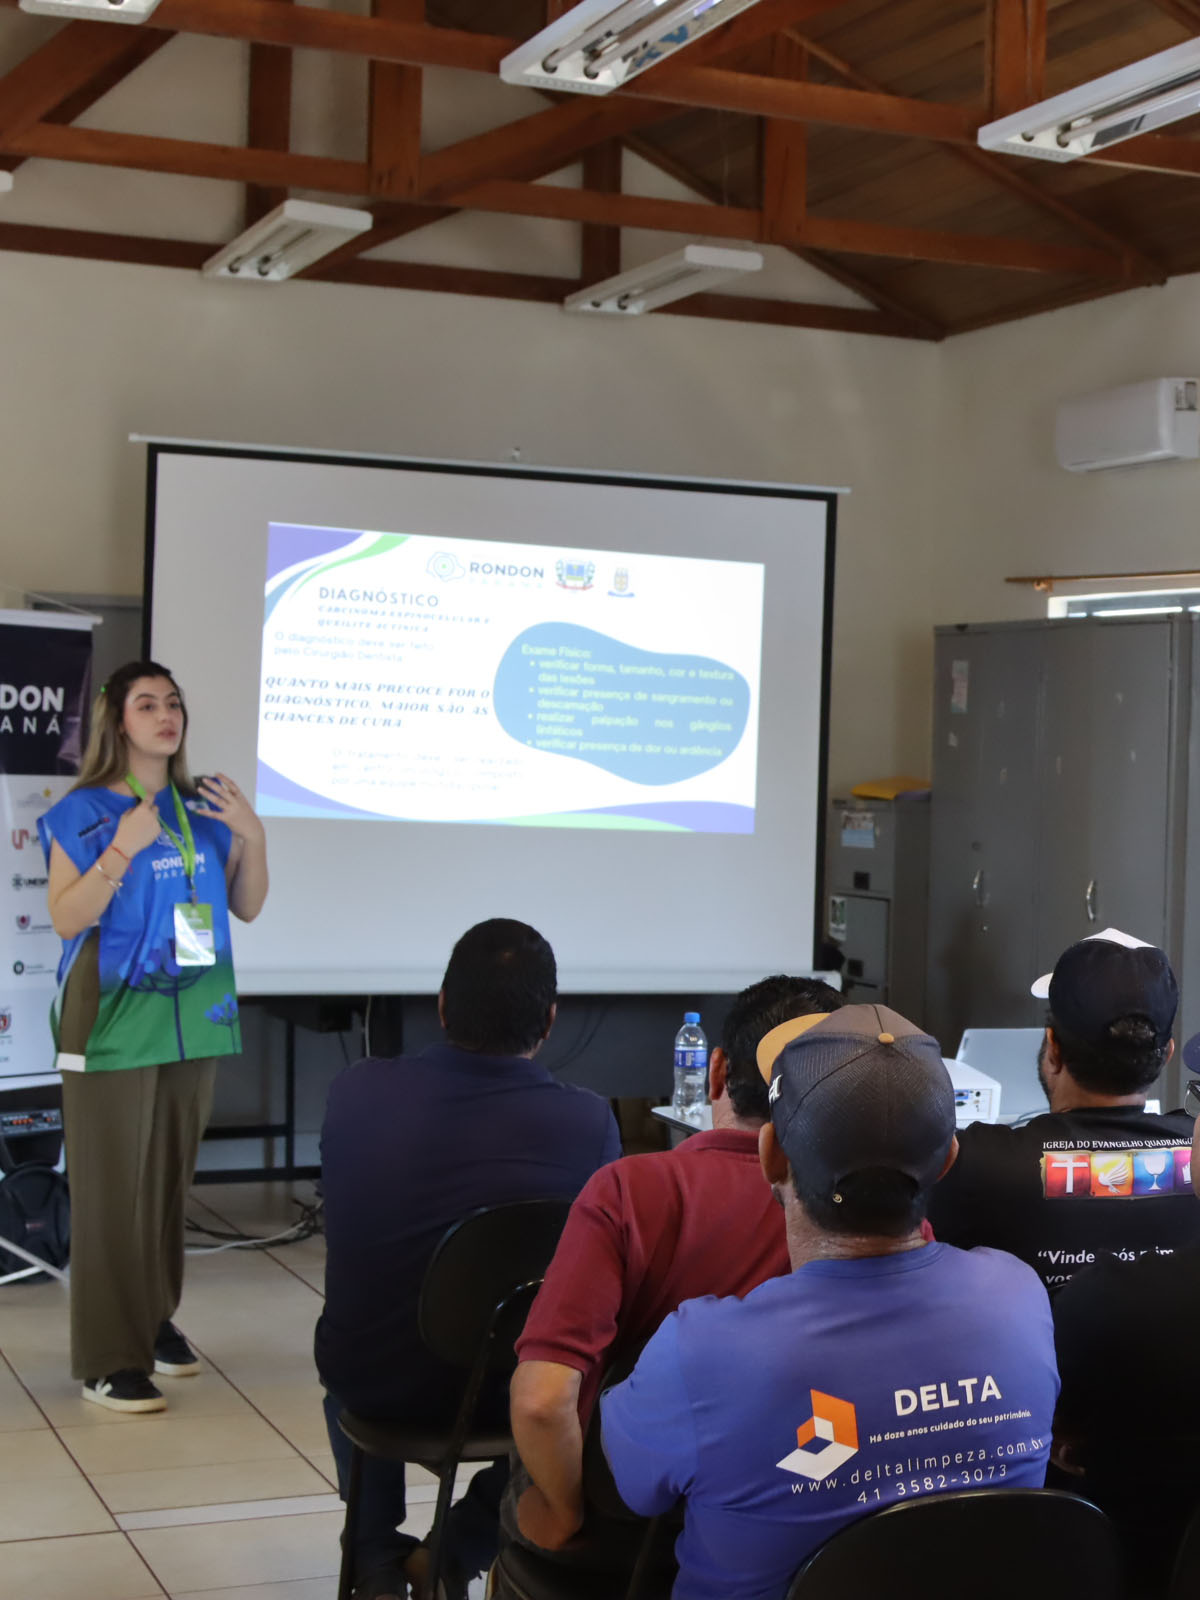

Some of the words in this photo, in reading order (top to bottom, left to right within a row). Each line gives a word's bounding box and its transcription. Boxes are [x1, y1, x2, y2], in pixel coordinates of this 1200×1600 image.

[469, 561, 545, 578] RONDON
[319, 585, 439, 608] DIAGNÓSTICO
[522, 643, 557, 657] Exame
[538, 673, 557, 683] das
[560, 673, 596, 686] lesões
[539, 659, 580, 670] verificar
[668, 669, 686, 678] cor
[688, 670, 696, 678] e
[699, 669, 735, 681] textura
[265, 676, 329, 690] QUANTO
[335, 680, 372, 692] MAIS
[377, 683, 442, 697] PRECOCE
[448, 687, 476, 698] FOR
[480, 689, 490, 699] O
[537, 686, 578, 697] verificar
[582, 690, 630, 702] presença
[634, 691, 648, 701] de
[651, 693, 717, 705] sangramento
[720, 697, 734, 706] ou
[0, 684, 64, 712] DON
[381, 700, 429, 713] MAIOR
[472, 706, 488, 716] AS
[536, 699, 604, 713] descamação
[0, 714, 61, 735] ANÁ
[264, 711, 334, 725] CHANCES
[339, 715, 357, 726] DE
[362, 716, 402, 728] CURA
[536, 712, 575, 723] realizar
[591, 716, 639, 728] palpação
[654, 719, 674, 728] nos
[689, 719, 732, 733] gânglios
[535, 738, 577, 750] verificar
[578, 741, 627, 753] presença
[629, 743, 642, 753] de
[645, 743, 662, 753] dor
[664, 745, 678, 754] ou
[680, 744, 723, 756] ardência
[152, 853, 205, 871] RONN
[1043, 1140, 1075, 1150] IGREJA
[1077, 1140, 1090, 1149] DO
[1092, 1140, 1144, 1148] EVANGELHO
[894, 1375, 1002, 1417] DELTA
[869, 1433, 882, 1444] Há
[884, 1430, 905, 1441] doze
[907, 1426, 928, 1437] anos
[930, 1419, 965, 1433] cuidado
[966, 1416, 978, 1427] do
[978, 1415, 993, 1425] seu
[791, 1437, 1044, 1495] www.deltalimpeza.com.br
[857, 1488, 881, 1504] 41
[896, 1463, 1008, 1496] 3582-3073
